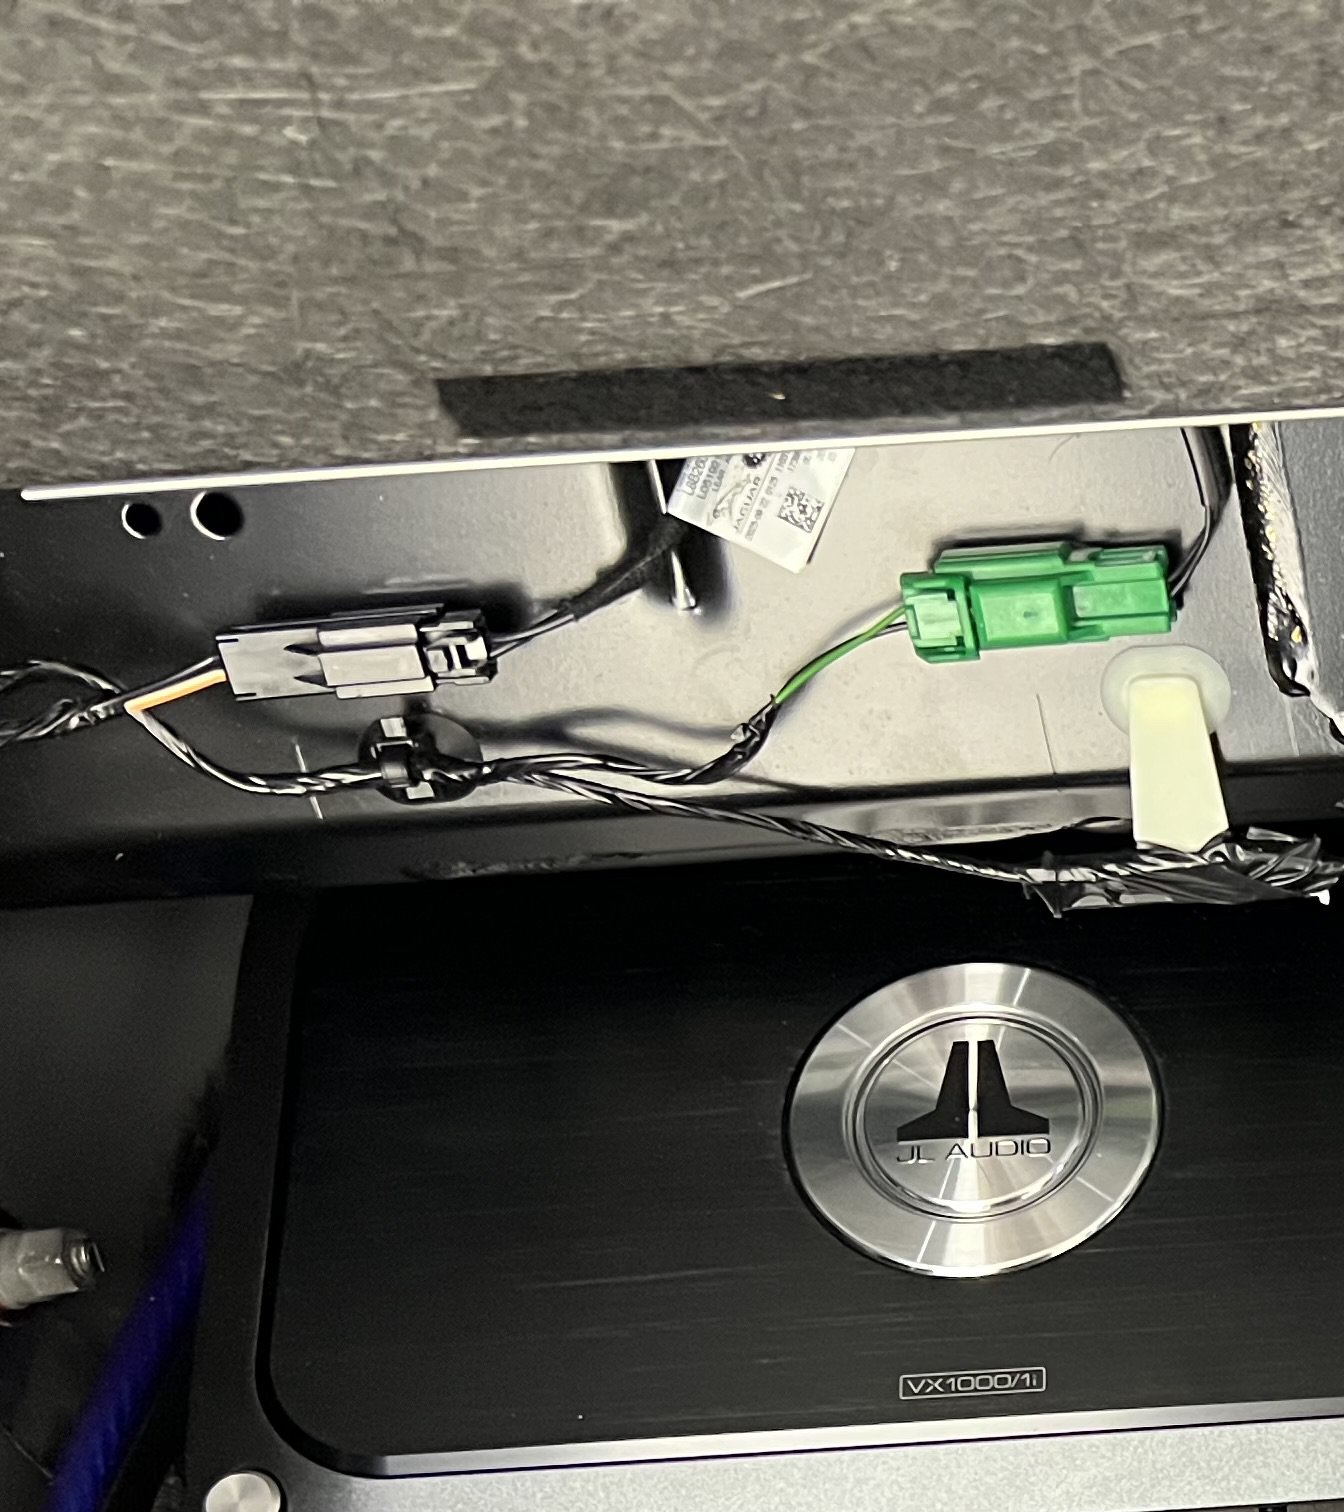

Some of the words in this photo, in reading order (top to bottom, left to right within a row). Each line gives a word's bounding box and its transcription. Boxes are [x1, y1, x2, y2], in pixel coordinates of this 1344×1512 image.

[896, 1143, 935, 1164] JL
[945, 1137, 1051, 1160] AUDIO
[907, 1373, 1037, 1394] VX1000/1i
